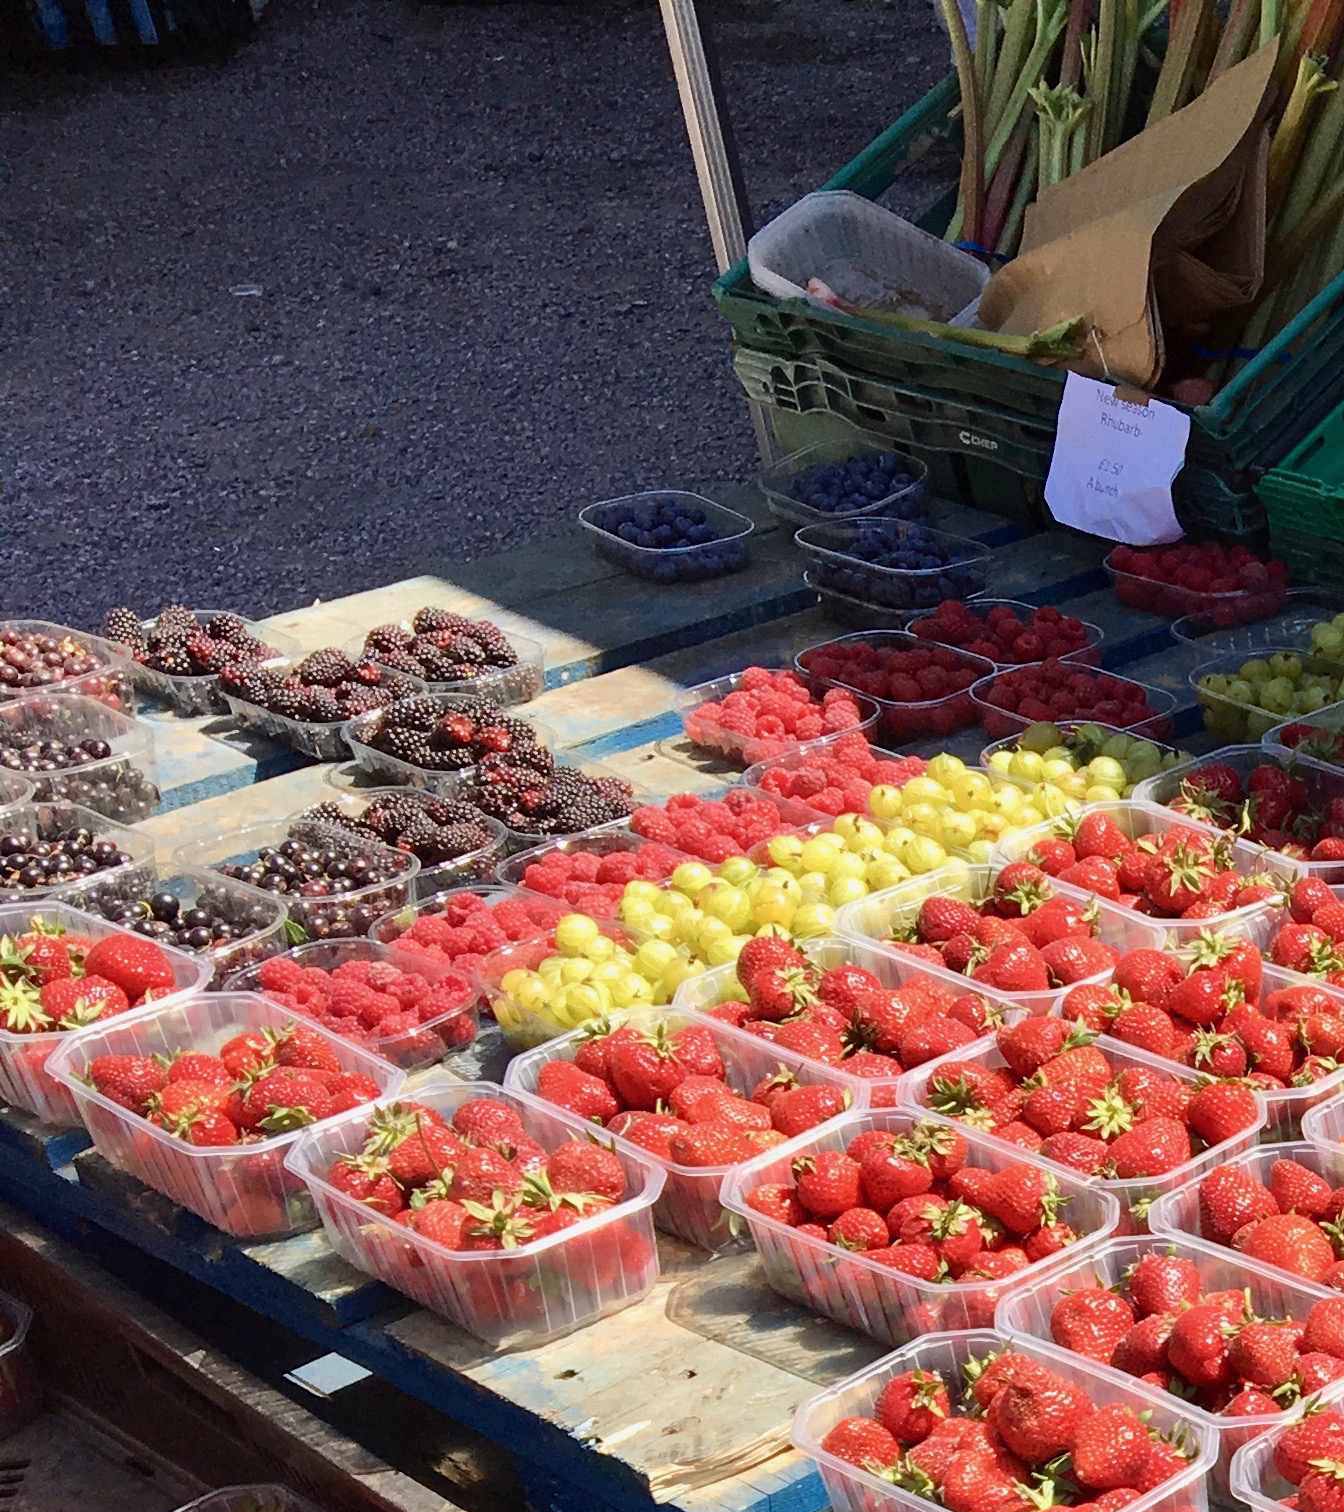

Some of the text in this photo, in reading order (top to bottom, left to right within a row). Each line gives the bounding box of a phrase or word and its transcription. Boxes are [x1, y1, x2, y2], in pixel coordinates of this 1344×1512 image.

[1096, 388, 1118, 408] New
[1087, 476, 1119, 498] A bunch
